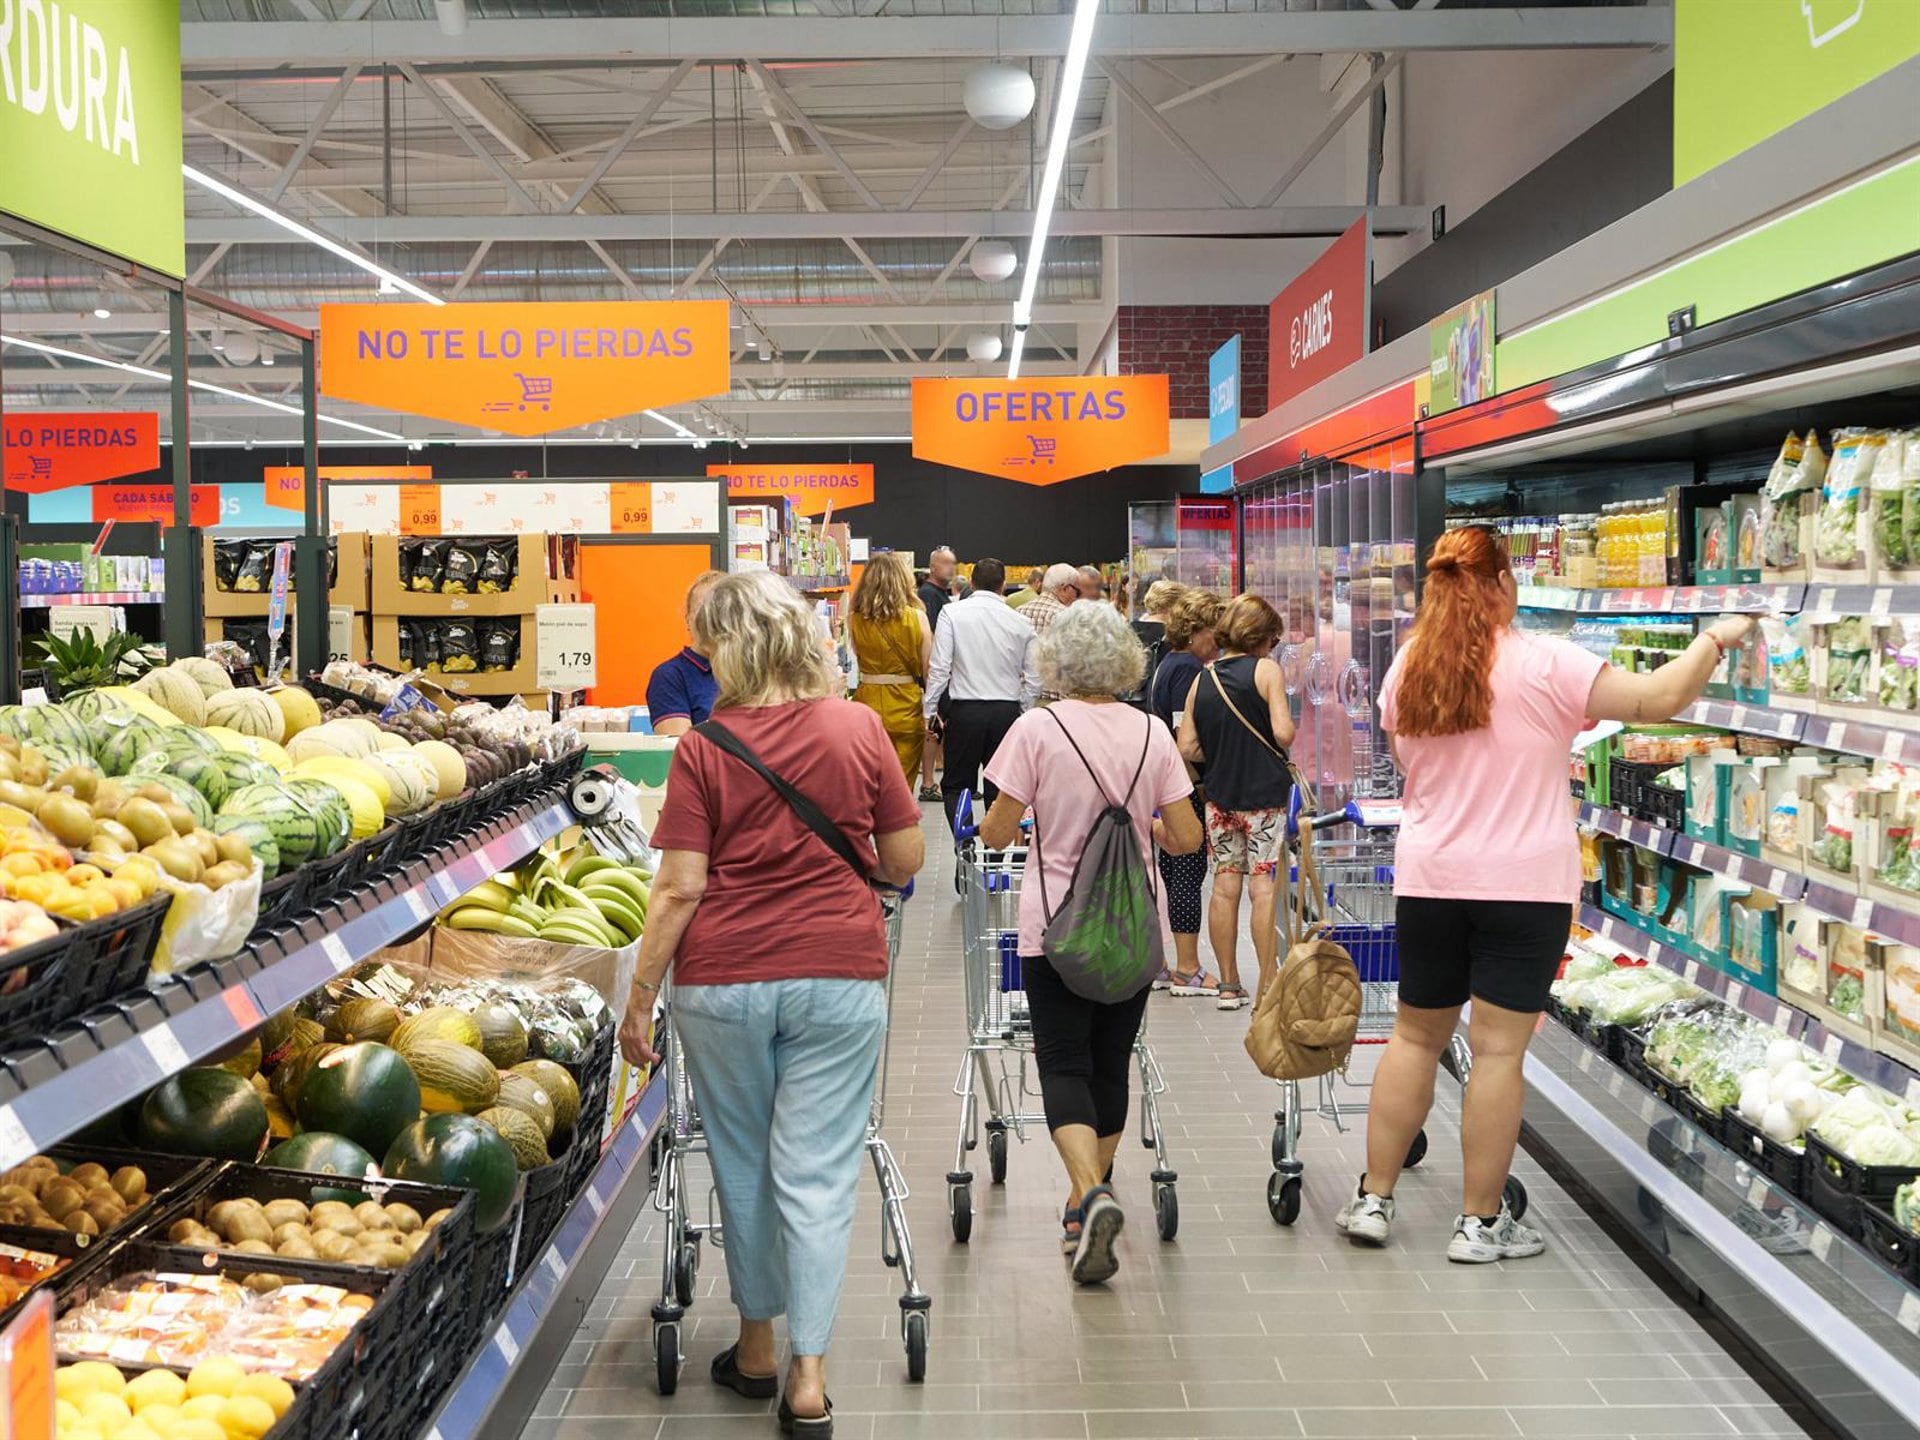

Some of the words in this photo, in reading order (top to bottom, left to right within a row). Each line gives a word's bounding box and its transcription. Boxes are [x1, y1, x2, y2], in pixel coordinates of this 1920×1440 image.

[1302, 288, 1333, 360] CARNES
[357, 329, 408, 359] NO
[420, 329, 464, 359] TE
[477, 329, 522, 359] LO
[535, 327, 694, 358] PIERDAS
[955, 390, 1126, 423] OFERTAS
[5, 428, 34, 447] LO
[40, 427, 137, 447] PIERDAS
[279, 478, 301, 490] NO
[747, 475, 765, 488] TE
[770, 475, 789, 488] LO
[793, 474, 860, 488] PIERDAS
[113, 493, 147, 503] CADA
[412, 513, 437, 525] 0,99
[623, 511, 648, 524] 0,99
[559, 652, 591, 668] 1,79
